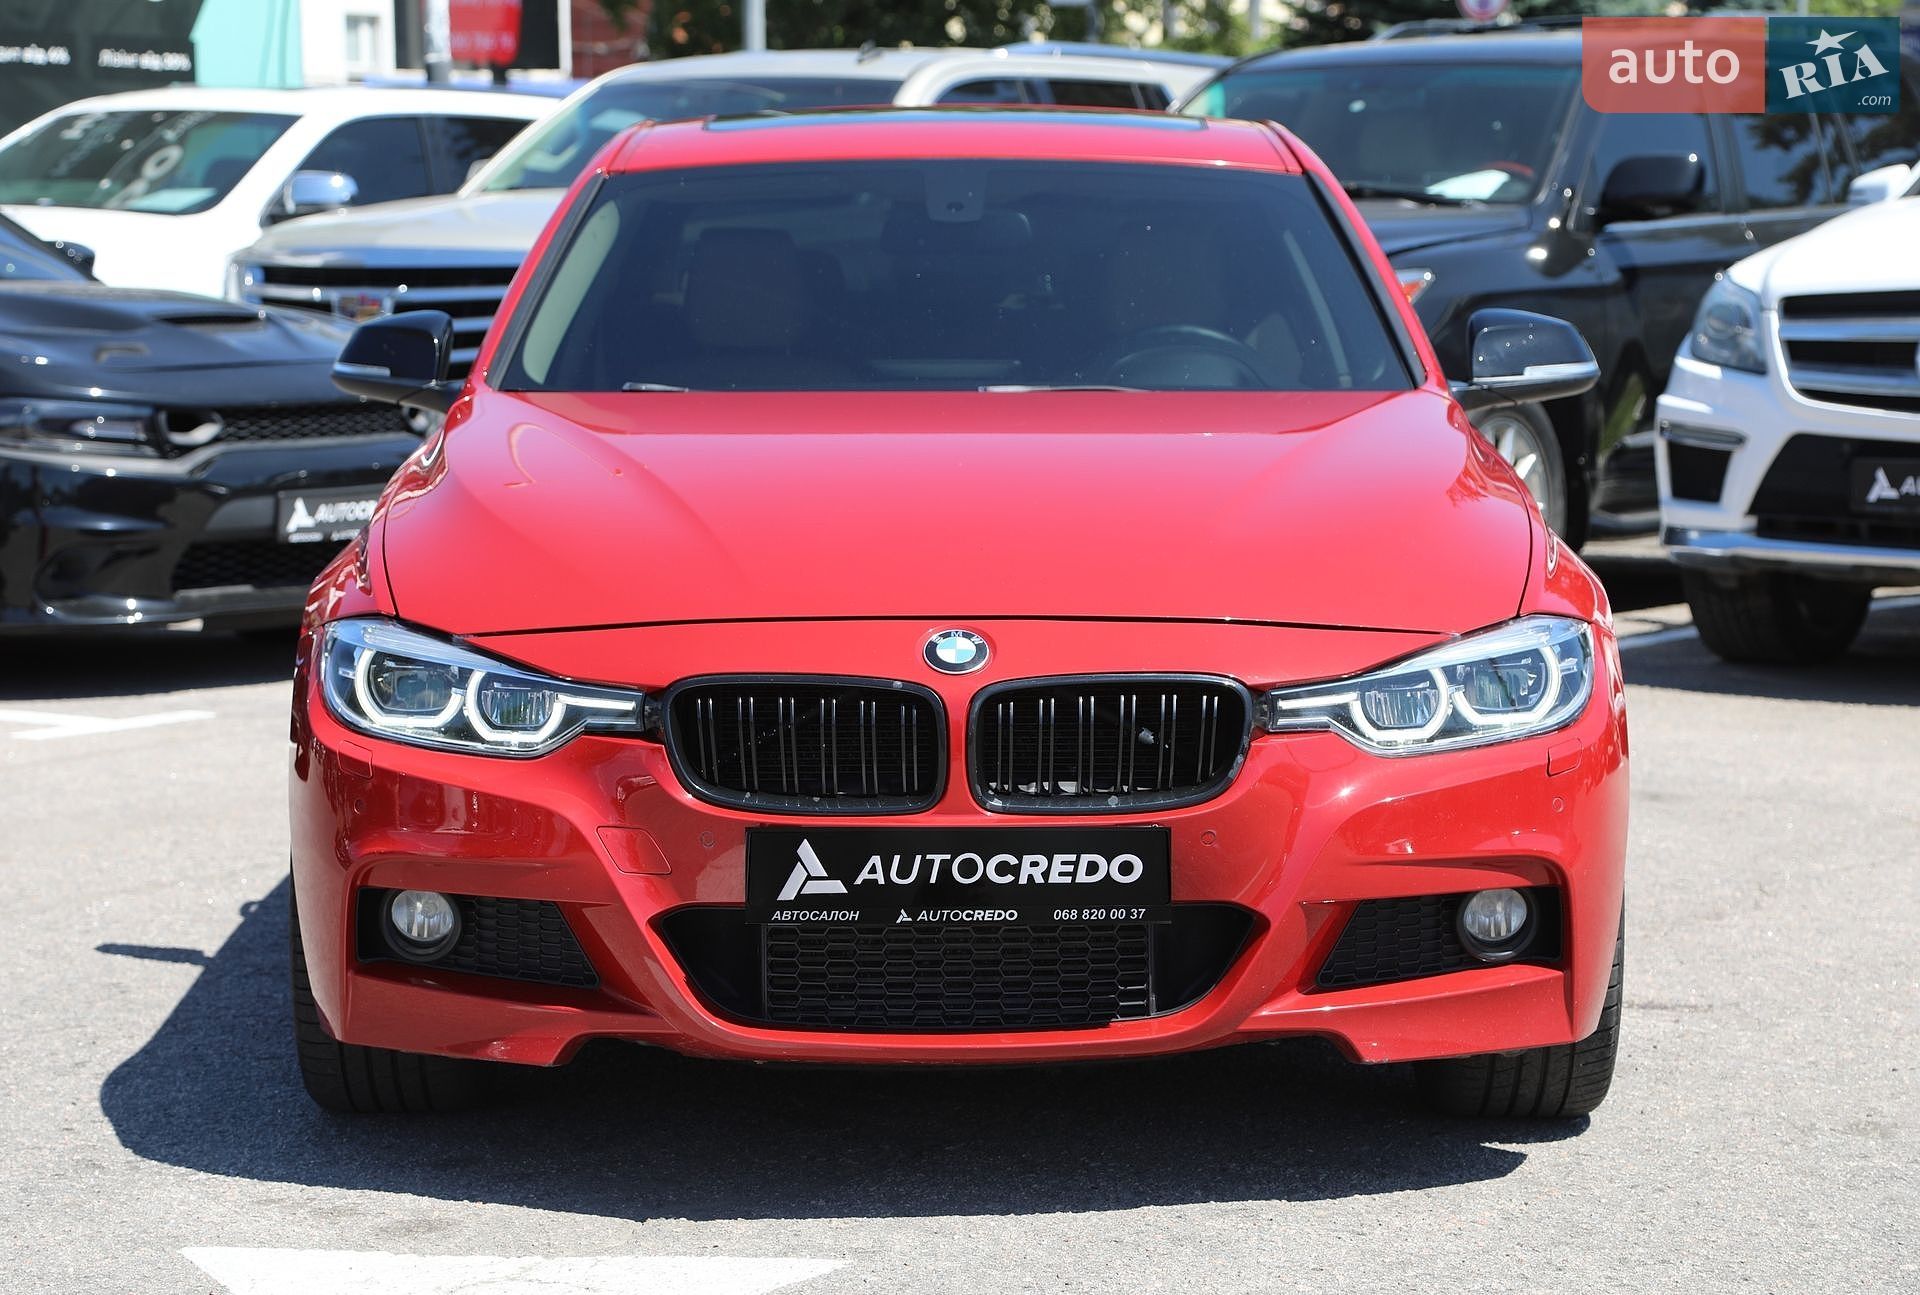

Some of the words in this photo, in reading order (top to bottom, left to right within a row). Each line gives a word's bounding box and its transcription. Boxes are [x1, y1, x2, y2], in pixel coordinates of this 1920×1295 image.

[931, 630, 985, 646] BMW
[853, 852, 1144, 885] AUTOCREDO
[771, 910, 860, 922] АВТОСАЛОН
[916, 909, 1018, 922] AUTOCREDO
[1053, 909, 1078, 921] 068
[1082, 909, 1106, 921] 820
[1110, 908, 1127, 920] 00
[1130, 908, 1147, 920] 37
